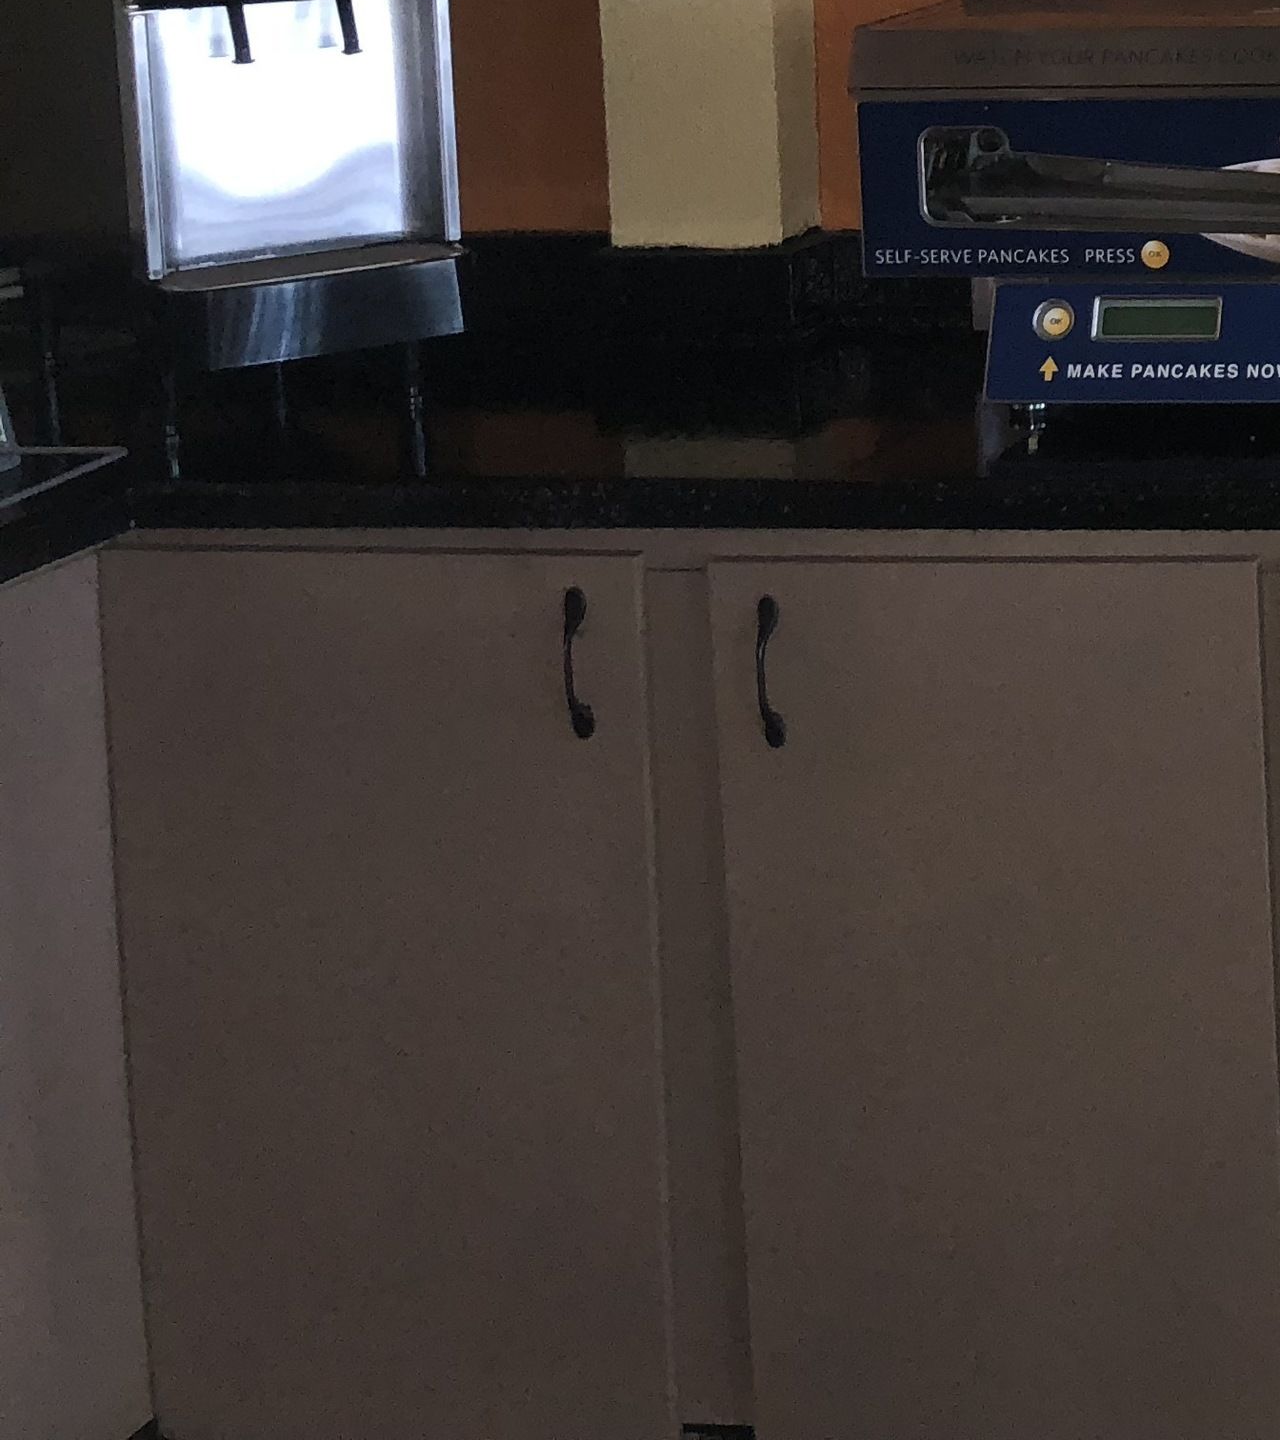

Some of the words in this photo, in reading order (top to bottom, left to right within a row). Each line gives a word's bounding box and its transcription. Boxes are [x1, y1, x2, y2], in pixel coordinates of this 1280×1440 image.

[875, 249, 972, 264] SELF-SERVE
[977, 248, 1070, 264] PANCAKES
[1085, 248, 1136, 264] PRESS
[1148, 250, 1162, 258] OK
[1066, 363, 1123, 379] MAKE
[1133, 363, 1240, 379] PANCAKES
